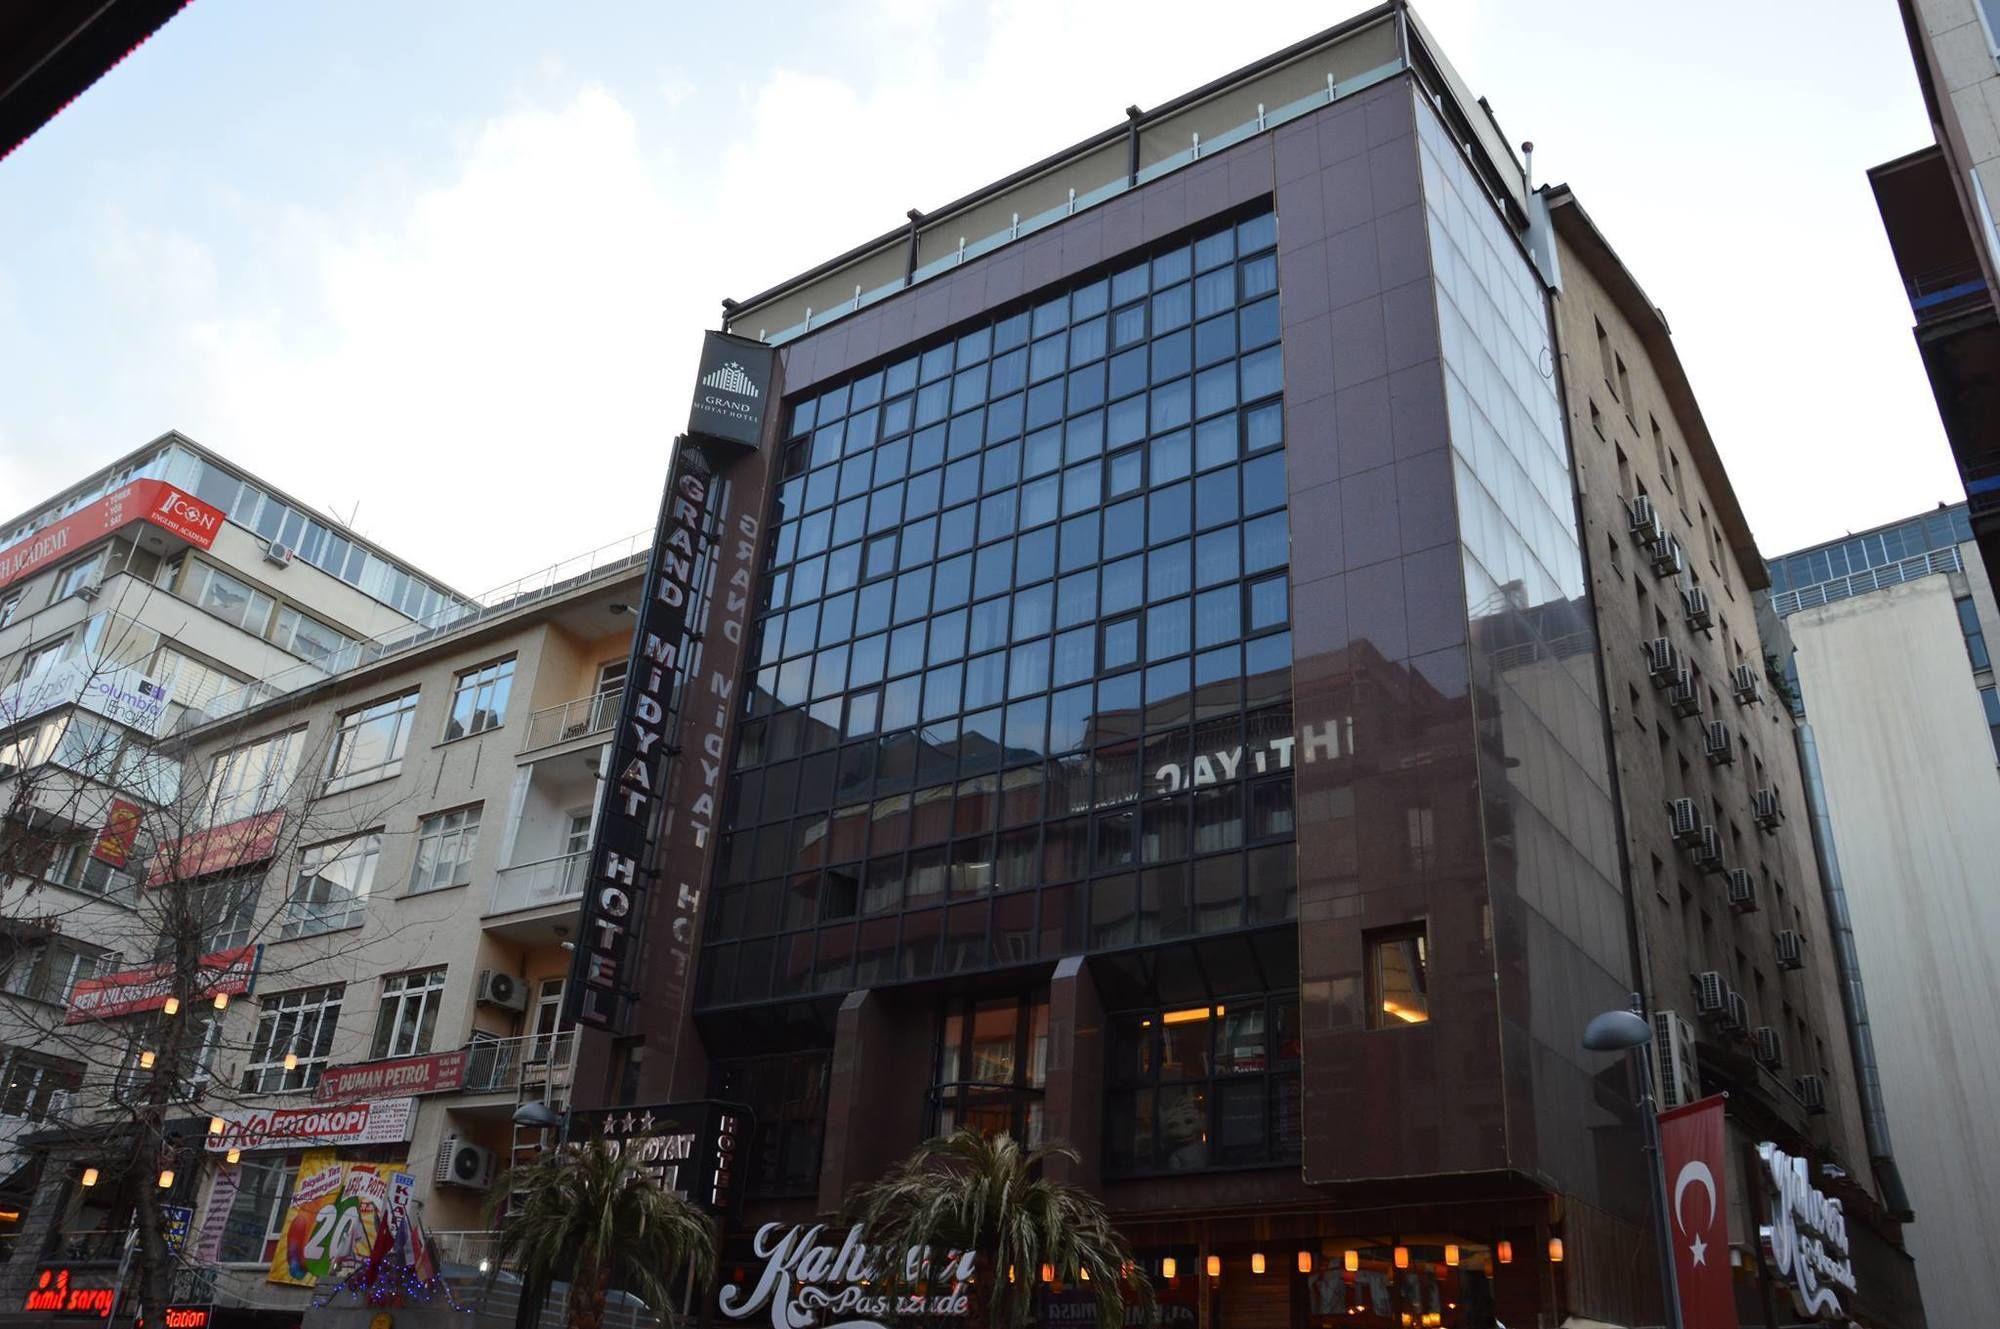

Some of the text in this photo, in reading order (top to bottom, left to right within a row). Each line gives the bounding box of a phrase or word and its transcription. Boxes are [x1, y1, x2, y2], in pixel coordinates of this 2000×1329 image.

[705, 395, 751, 413] GRAND
[730, 411, 758, 423] HOTEL
[151, 511, 210, 545] ENGLISH ACADEMY
[159, 490, 216, 531] ICON
[11, 526, 70, 573] ACADEMY
[657, 473, 704, 610] GRAND
[88, 675, 161, 716] Columbia
[582, 850, 636, 1024] HOTEL
[338, 1070, 384, 1093] DUMAN
[384, 1063, 431, 1087] PETROL
[711, 1114, 737, 1207] HOTEL
